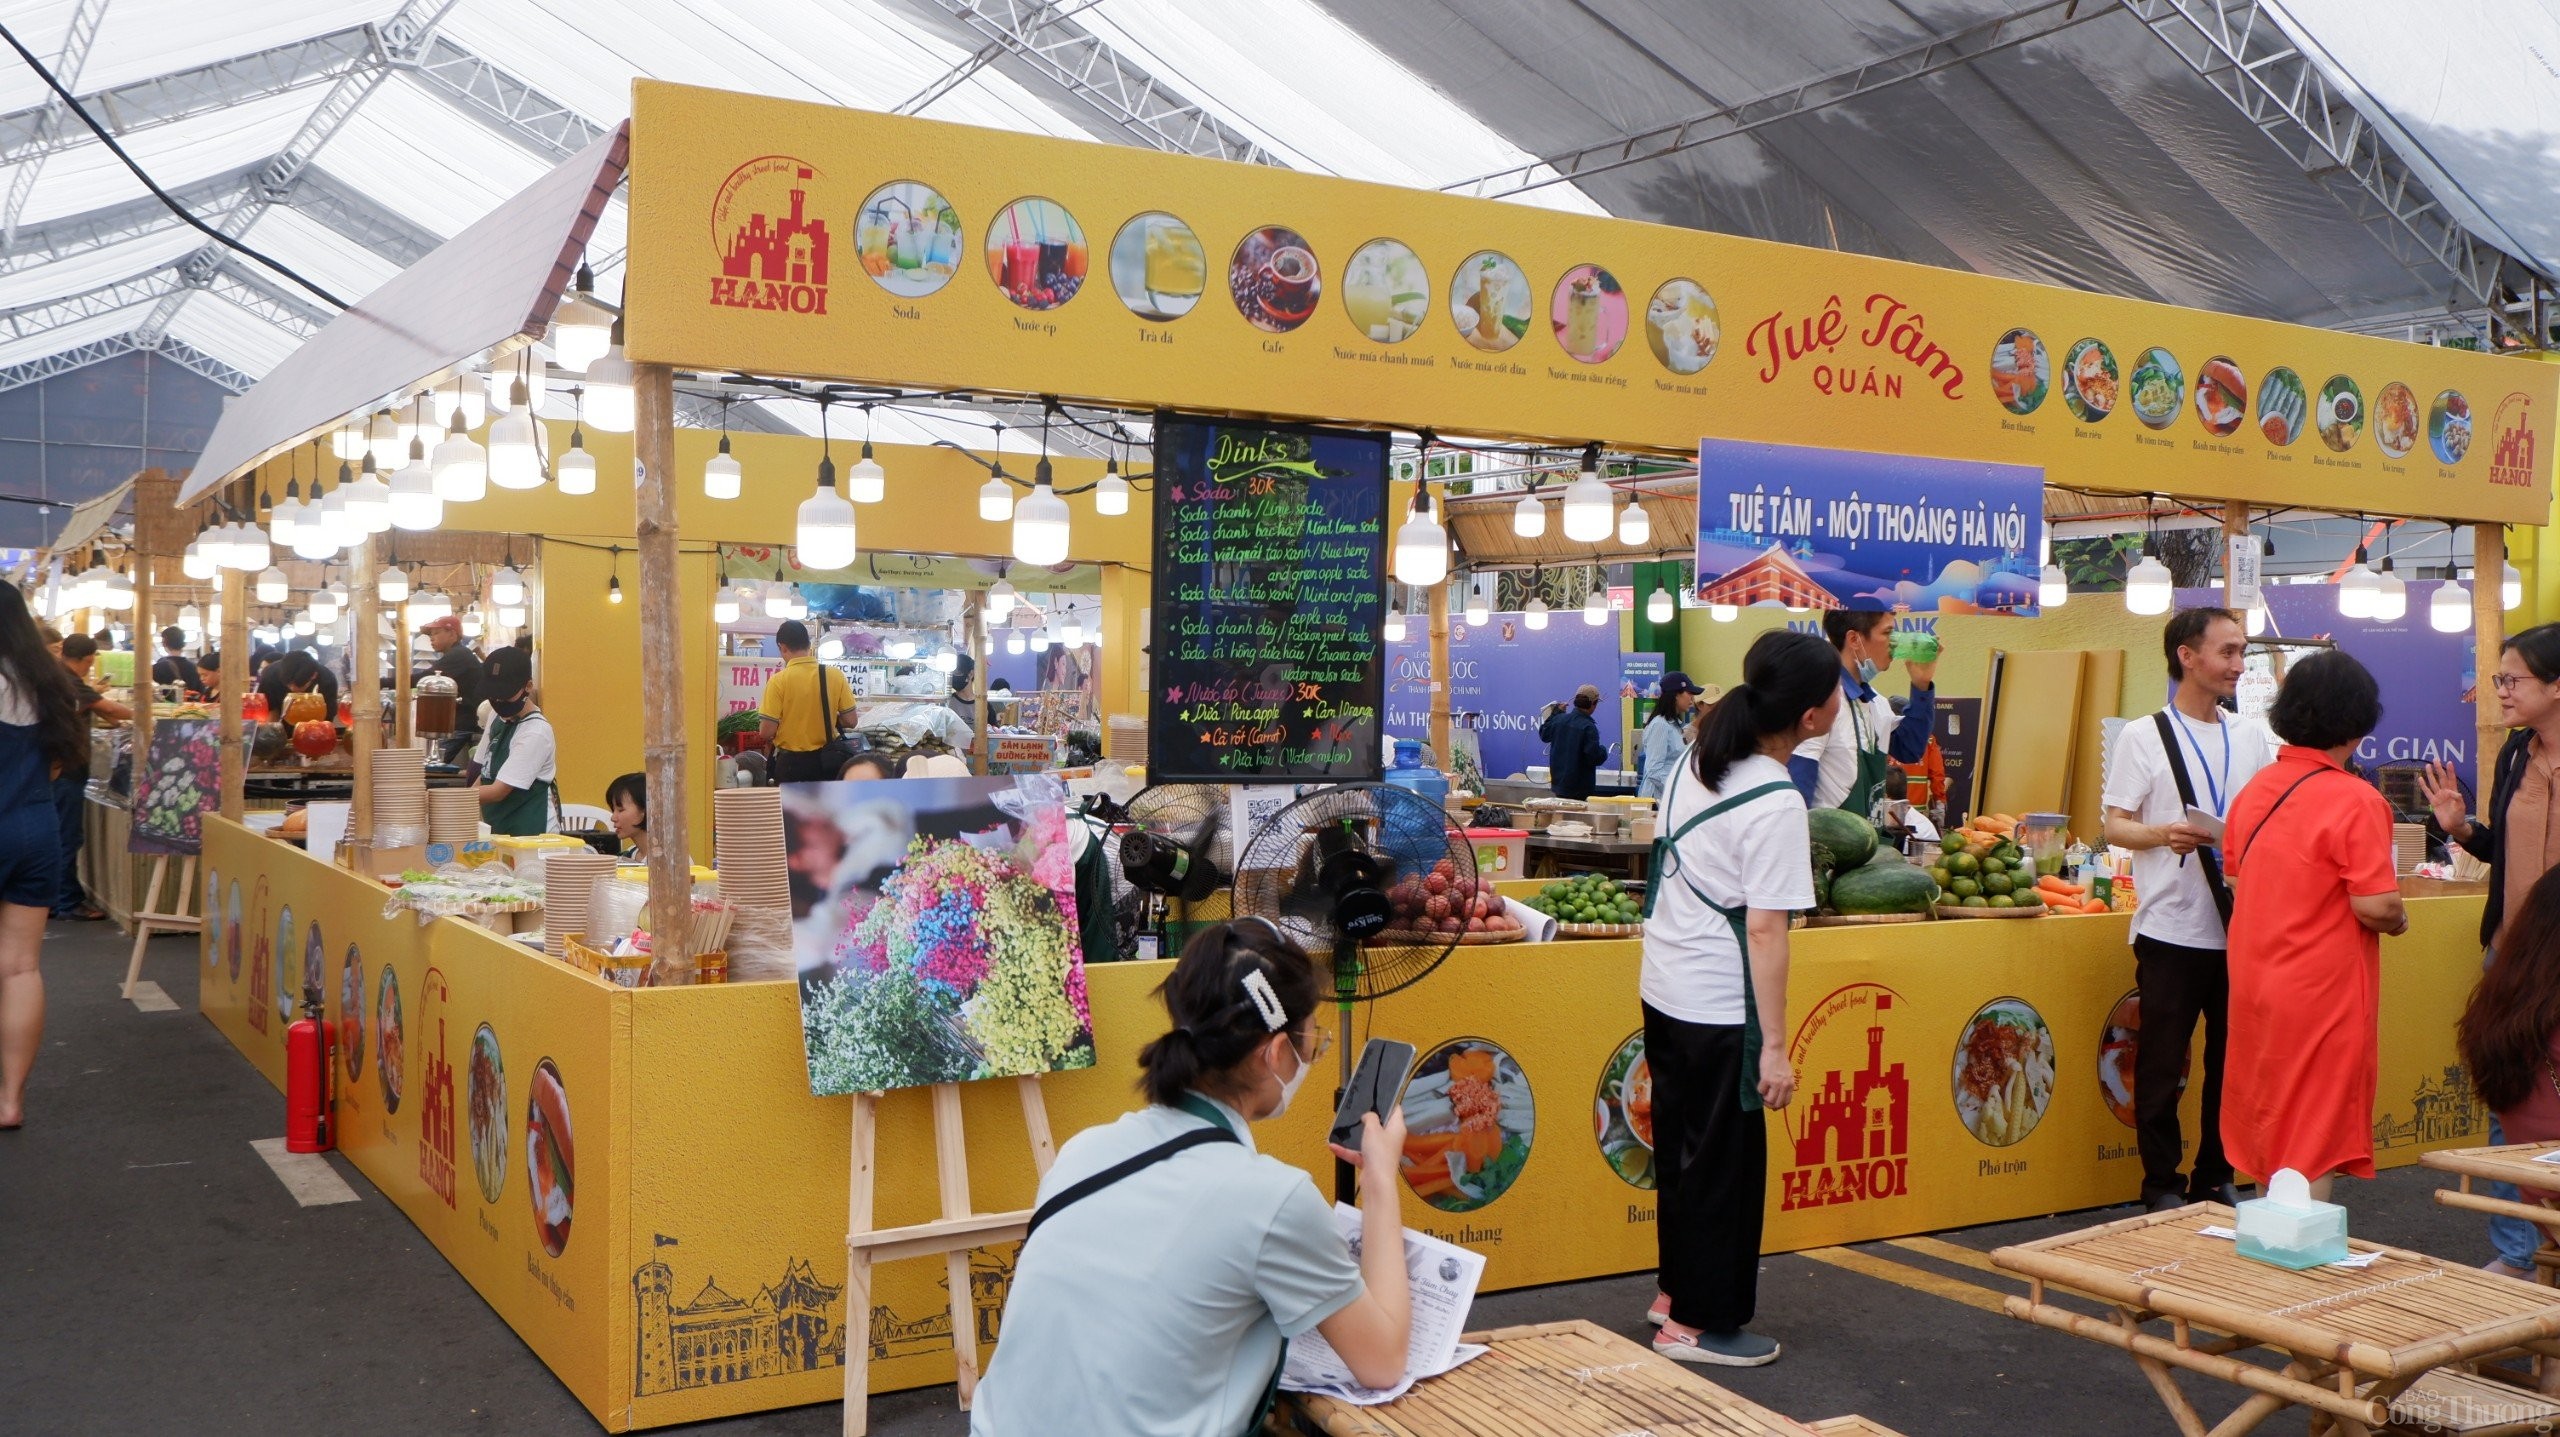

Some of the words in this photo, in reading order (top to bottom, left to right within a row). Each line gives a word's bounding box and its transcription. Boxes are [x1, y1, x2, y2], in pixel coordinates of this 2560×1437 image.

[710, 276, 829, 315] HANOI
[892, 304, 921, 320] Soda
[1013, 317, 1041, 333] Nước
[1043, 321, 1057, 336] ép
[1138, 328, 1157, 344] Trà
[1262, 339, 1285, 354] Cafe
[1746, 294, 1848, 384] Tuệ
[1862, 293, 1964, 400] Tâm
[1813, 365, 1902, 399] QUÁN
[2489, 466, 2533, 487] HANOI
[1190, 481, 1237, 501] Soda
[1248, 476, 1276, 496] 30K
[1180, 505, 1209, 523] Soda
[1212, 502, 1253, 520] chanh
[1296, 499, 1326, 517] soda
[1729, 483, 1765, 546] TUỆ
[1769, 486, 1812, 537] TÂM
[1829, 490, 1872, 551] MỘT
[1876, 495, 1957, 546] THOÁNG
[1962, 500, 1989, 547] HÀ
[1993, 502, 2026, 559] NỘI
[1180, 525, 1210, 542] Soda
[1212, 523, 1251, 540] chanh
[1361, 517, 1380, 533] soda
[1179, 544, 1210, 564] Soda
[1267, 565, 1291, 582] and
[1346, 564, 1372, 580] soda
[1180, 582, 1205, 601] Soda
[1330, 585, 1355, 604] and
[1181, 615, 1212, 636] Soda
[1215, 616, 1253, 636] chanh
[1325, 608, 1348, 625] soda
[1180, 640, 1209, 660] Soda
[1352, 644, 1377, 662] and
[731, 663, 760, 687] TRÀ
[850, 663, 868, 674] MÍA
[1340, 664, 1364, 682] soda
[1296, 682, 1322, 702] 30K
[1315, 700, 1336, 719] Cam
[1492, 710, 1527, 731] SÔNG
[1001, 740, 1019, 750] SÂM
[2387, 735, 2465, 764] GIAN
[1944, 758, 1963, 767] GOLF
[1801, 1014, 1828, 1046] healthy
[1827, 993, 1848, 1018] street
[1849, 990, 1869, 1010] food
[2097, 1141, 2125, 1161] Bánh
[419, 1139, 457, 1212] HANOI
[1978, 1158, 2001, 1178] Phở
[2003, 1158, 2028, 1176] trộn
[1781, 1157, 1909, 1212] HANOI
[1627, 1205, 1655, 1224] Bún
[1458, 1223, 1503, 1246] thang
